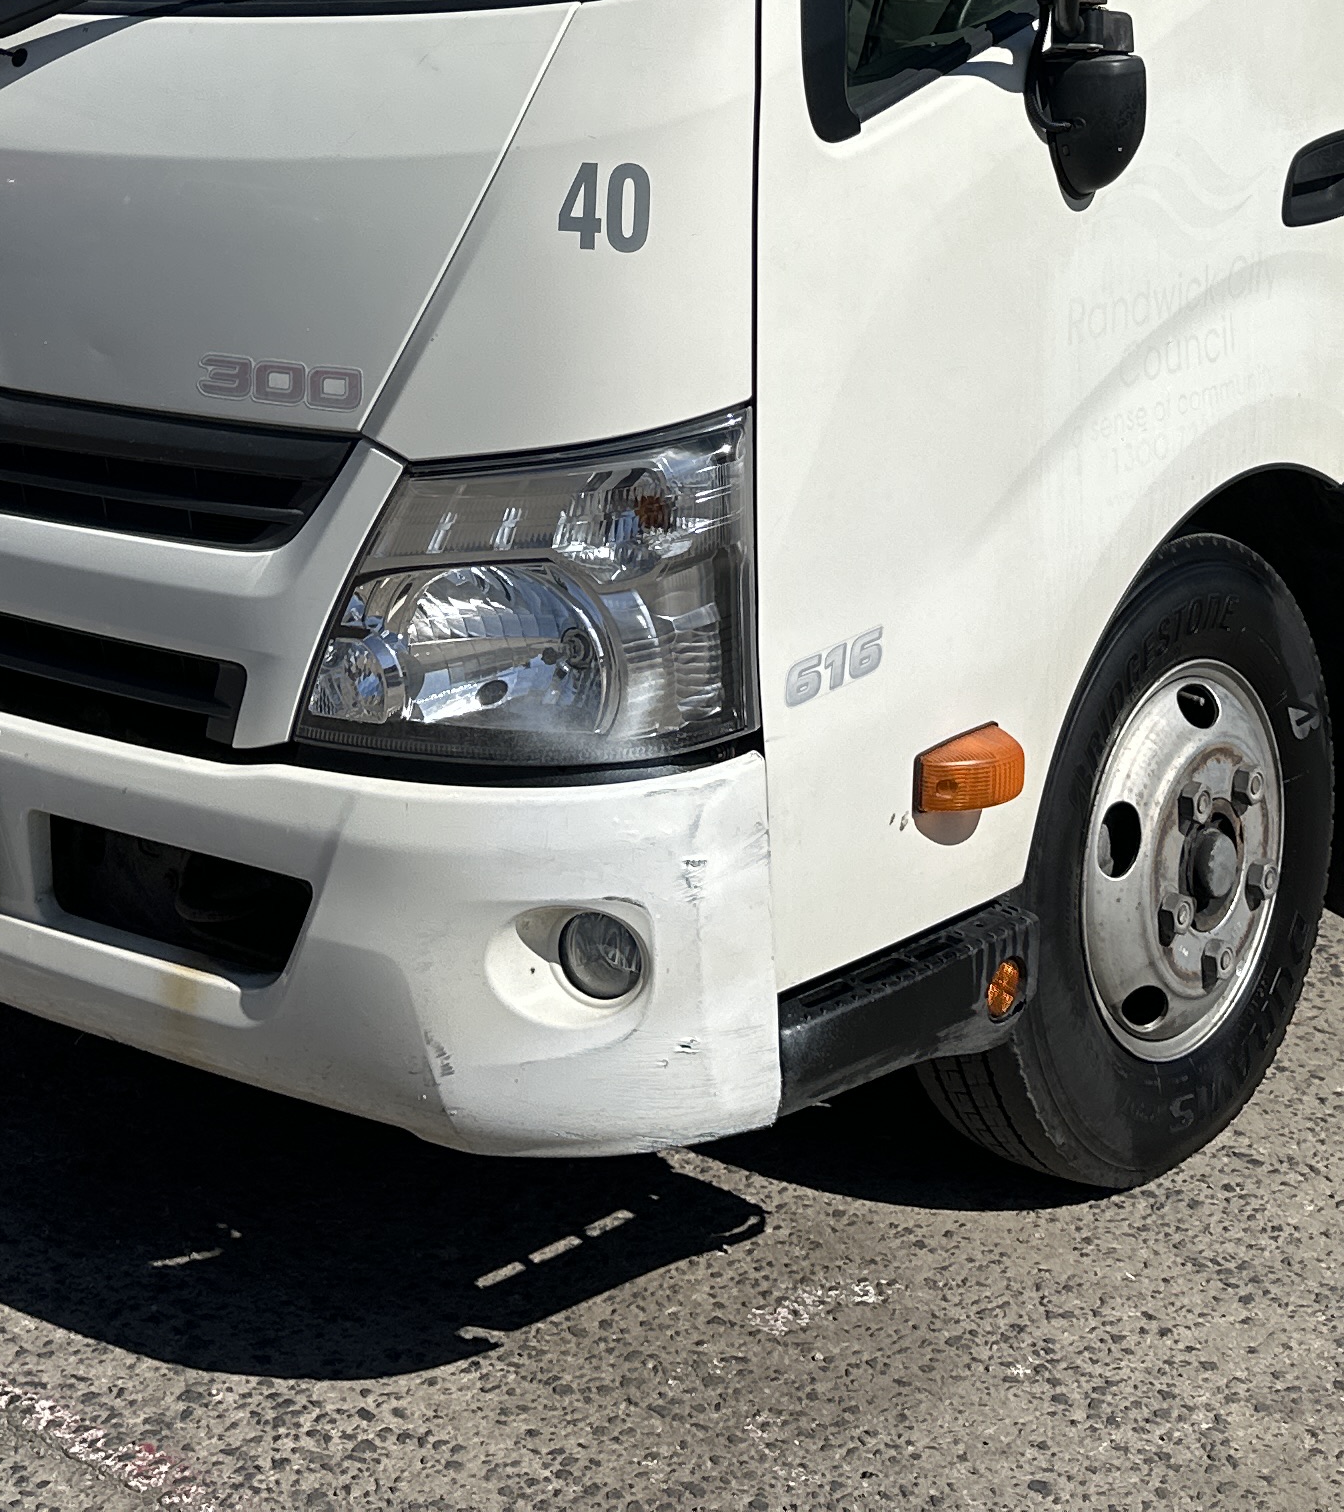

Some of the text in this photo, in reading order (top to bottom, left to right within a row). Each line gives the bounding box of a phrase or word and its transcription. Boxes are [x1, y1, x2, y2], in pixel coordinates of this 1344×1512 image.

[558, 162, 650, 252] 40
[197, 351, 364, 414] 300
[785, 625, 884, 708] 616
